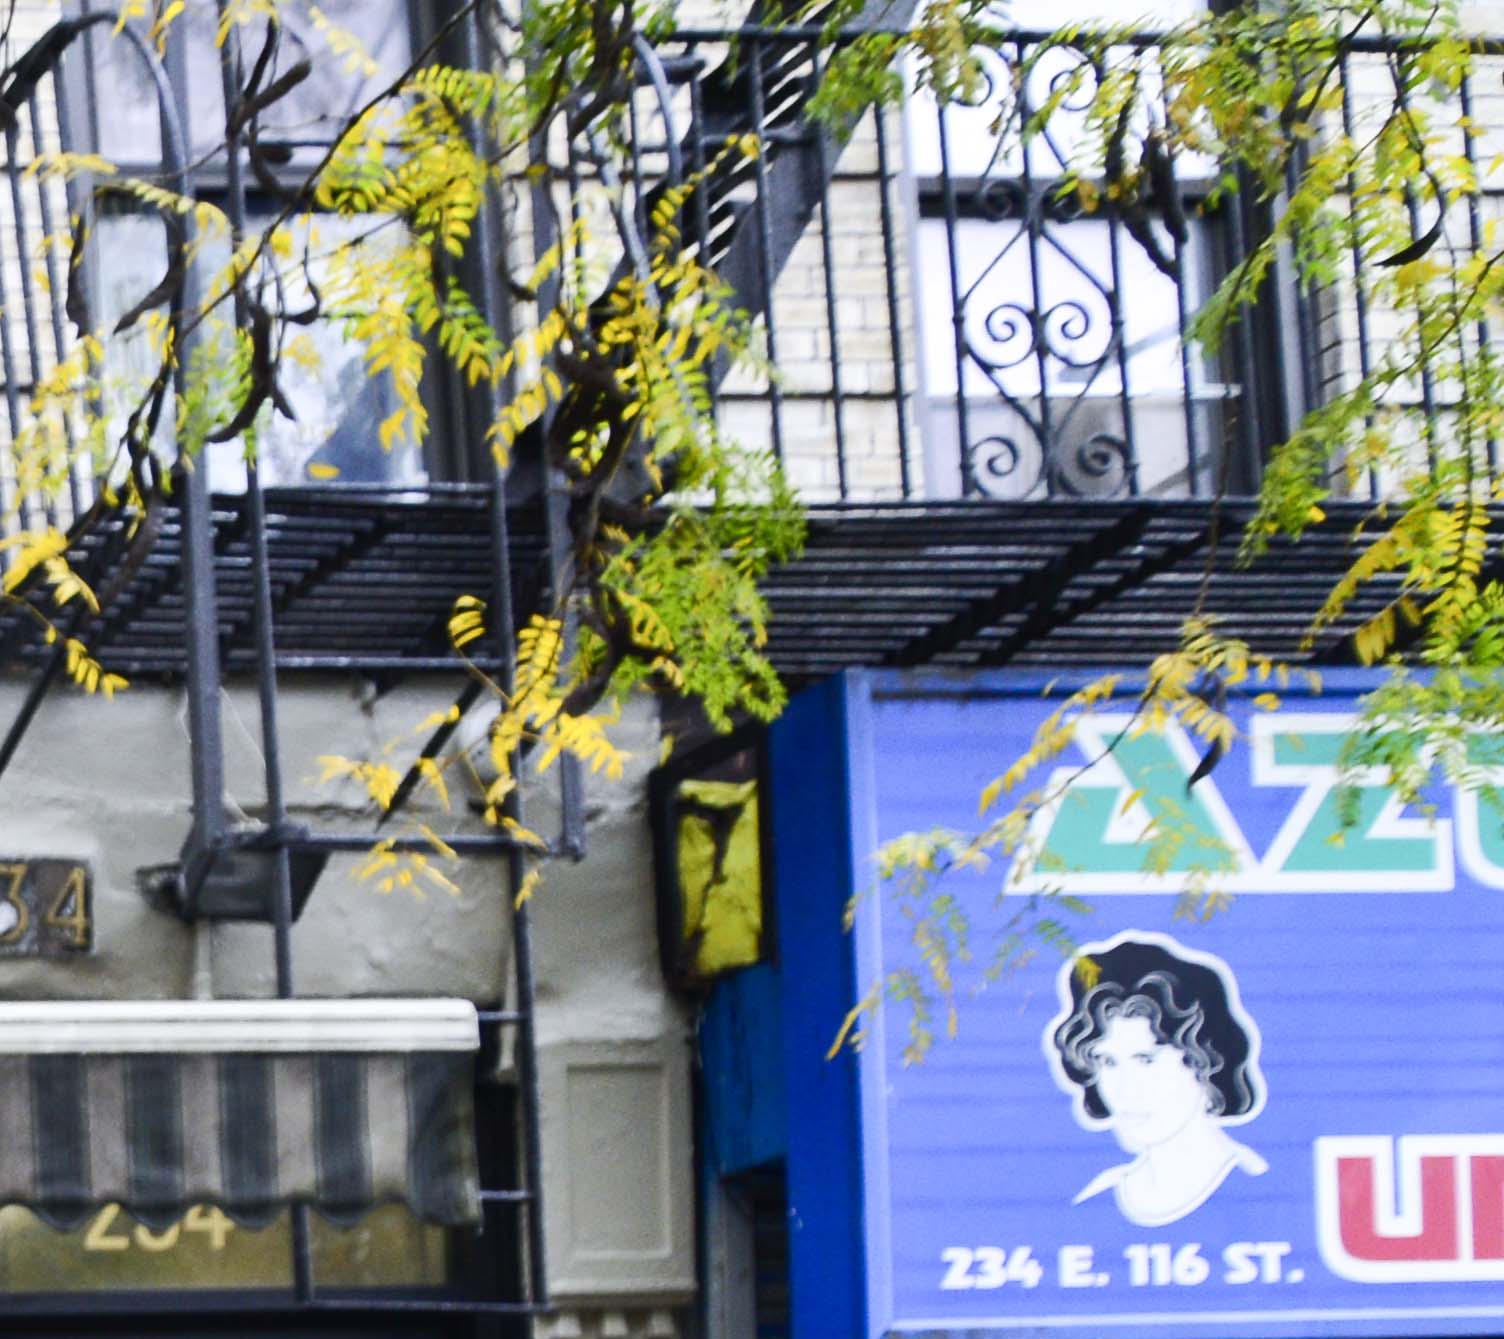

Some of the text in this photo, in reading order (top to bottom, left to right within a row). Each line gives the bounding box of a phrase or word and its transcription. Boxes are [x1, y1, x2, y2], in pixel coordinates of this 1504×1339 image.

[1003, 711, 1504, 895] AZ
[940, 1241, 1305, 1291] 234 E. 116 ST.
